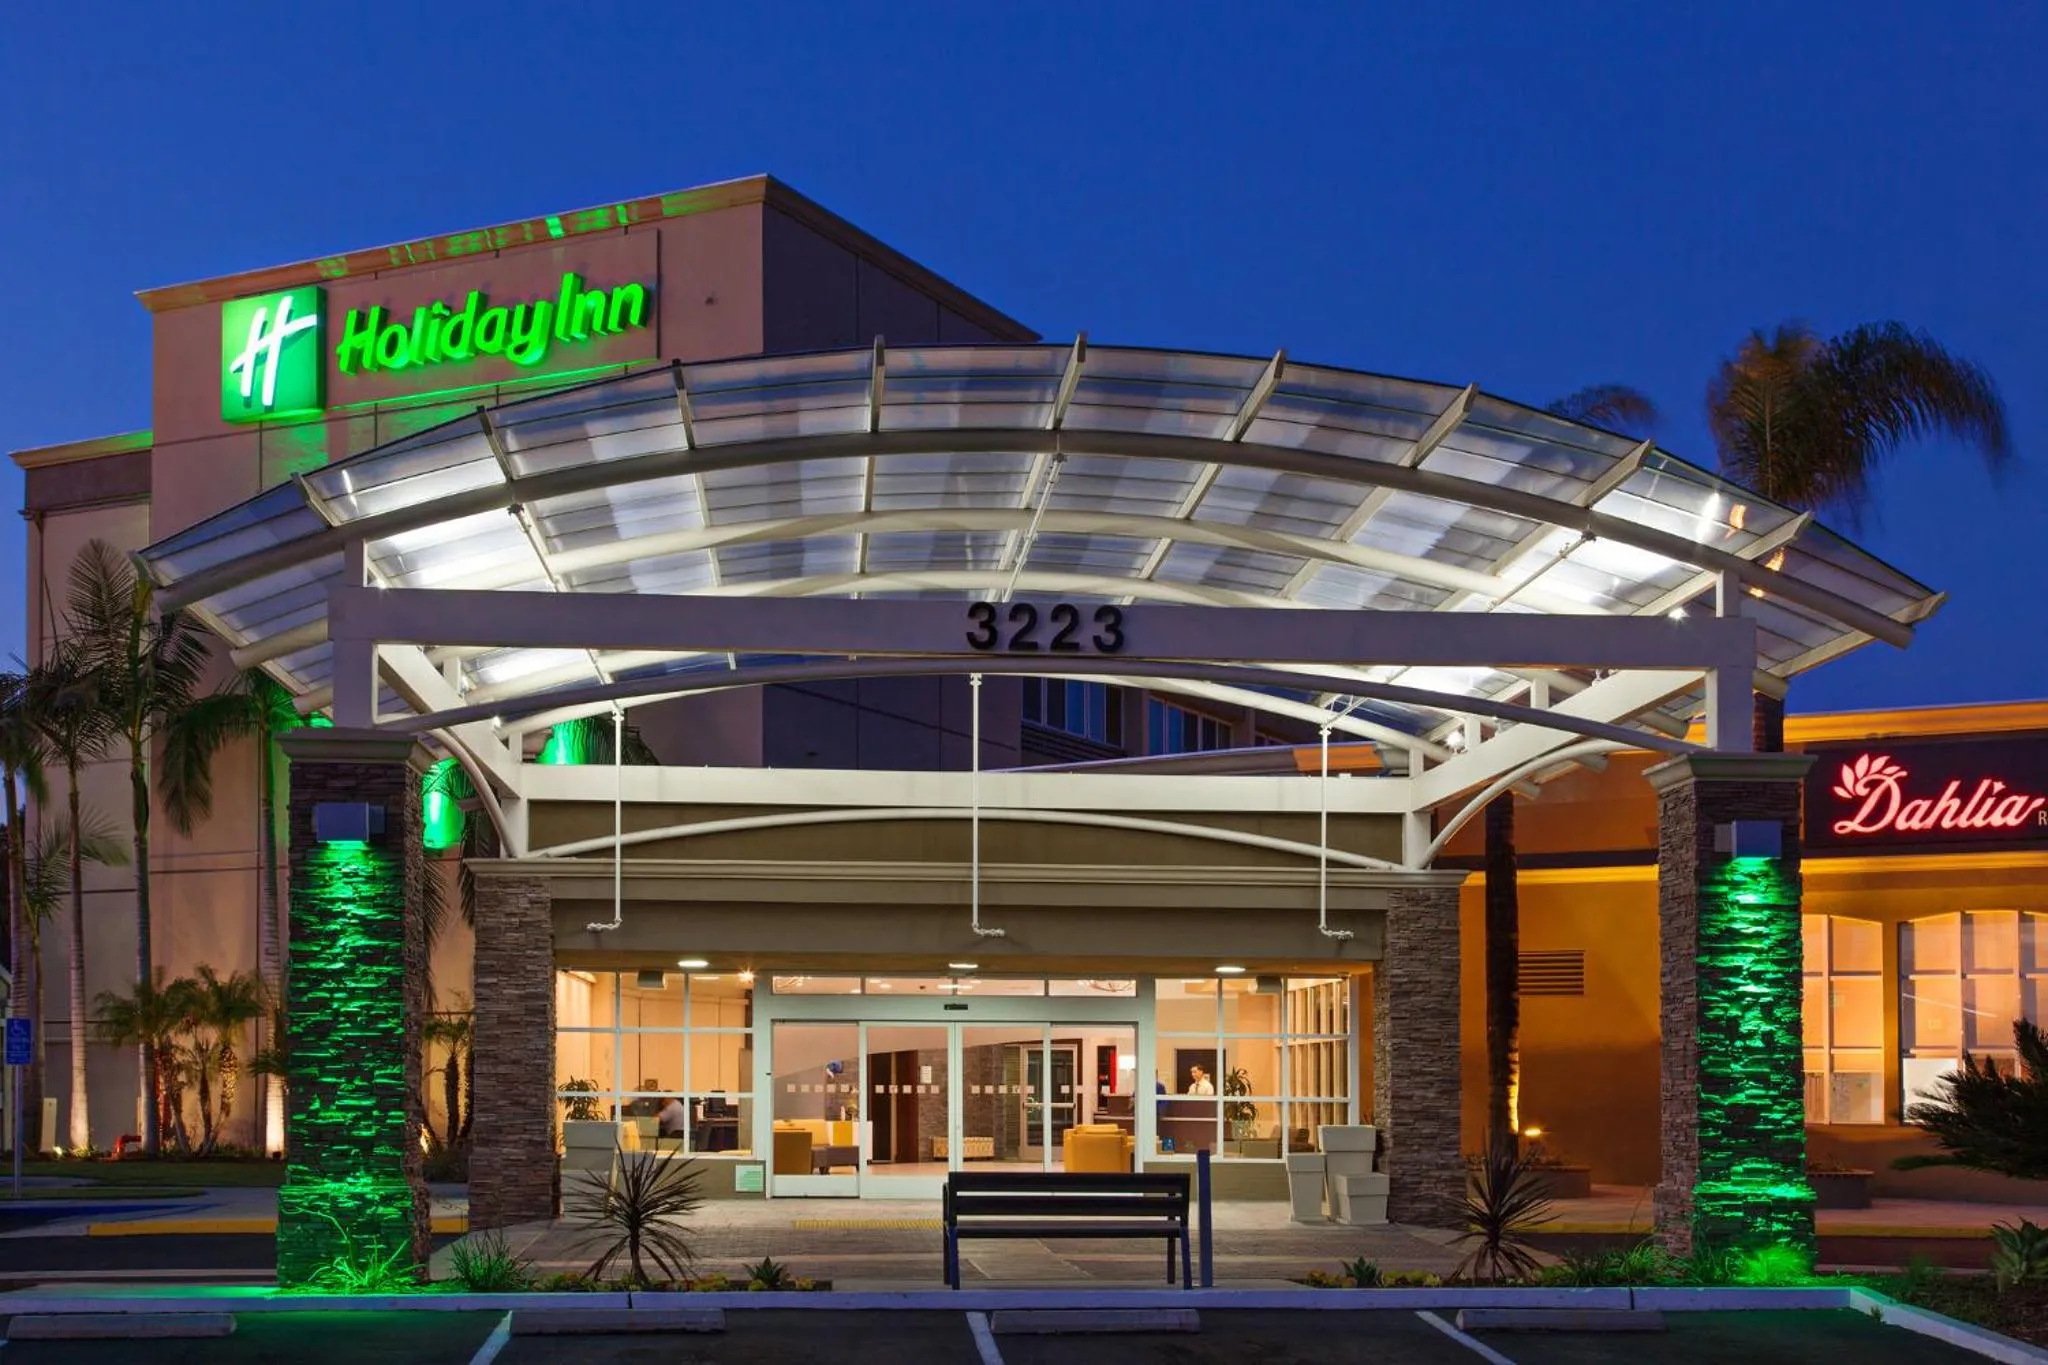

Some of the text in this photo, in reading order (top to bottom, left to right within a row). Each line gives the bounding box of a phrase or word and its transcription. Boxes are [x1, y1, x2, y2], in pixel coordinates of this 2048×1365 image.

[337, 272, 650, 376] Holiday Inn
[966, 601, 1125, 653] 3223
[1833, 768, 2047, 834] Dahlia
